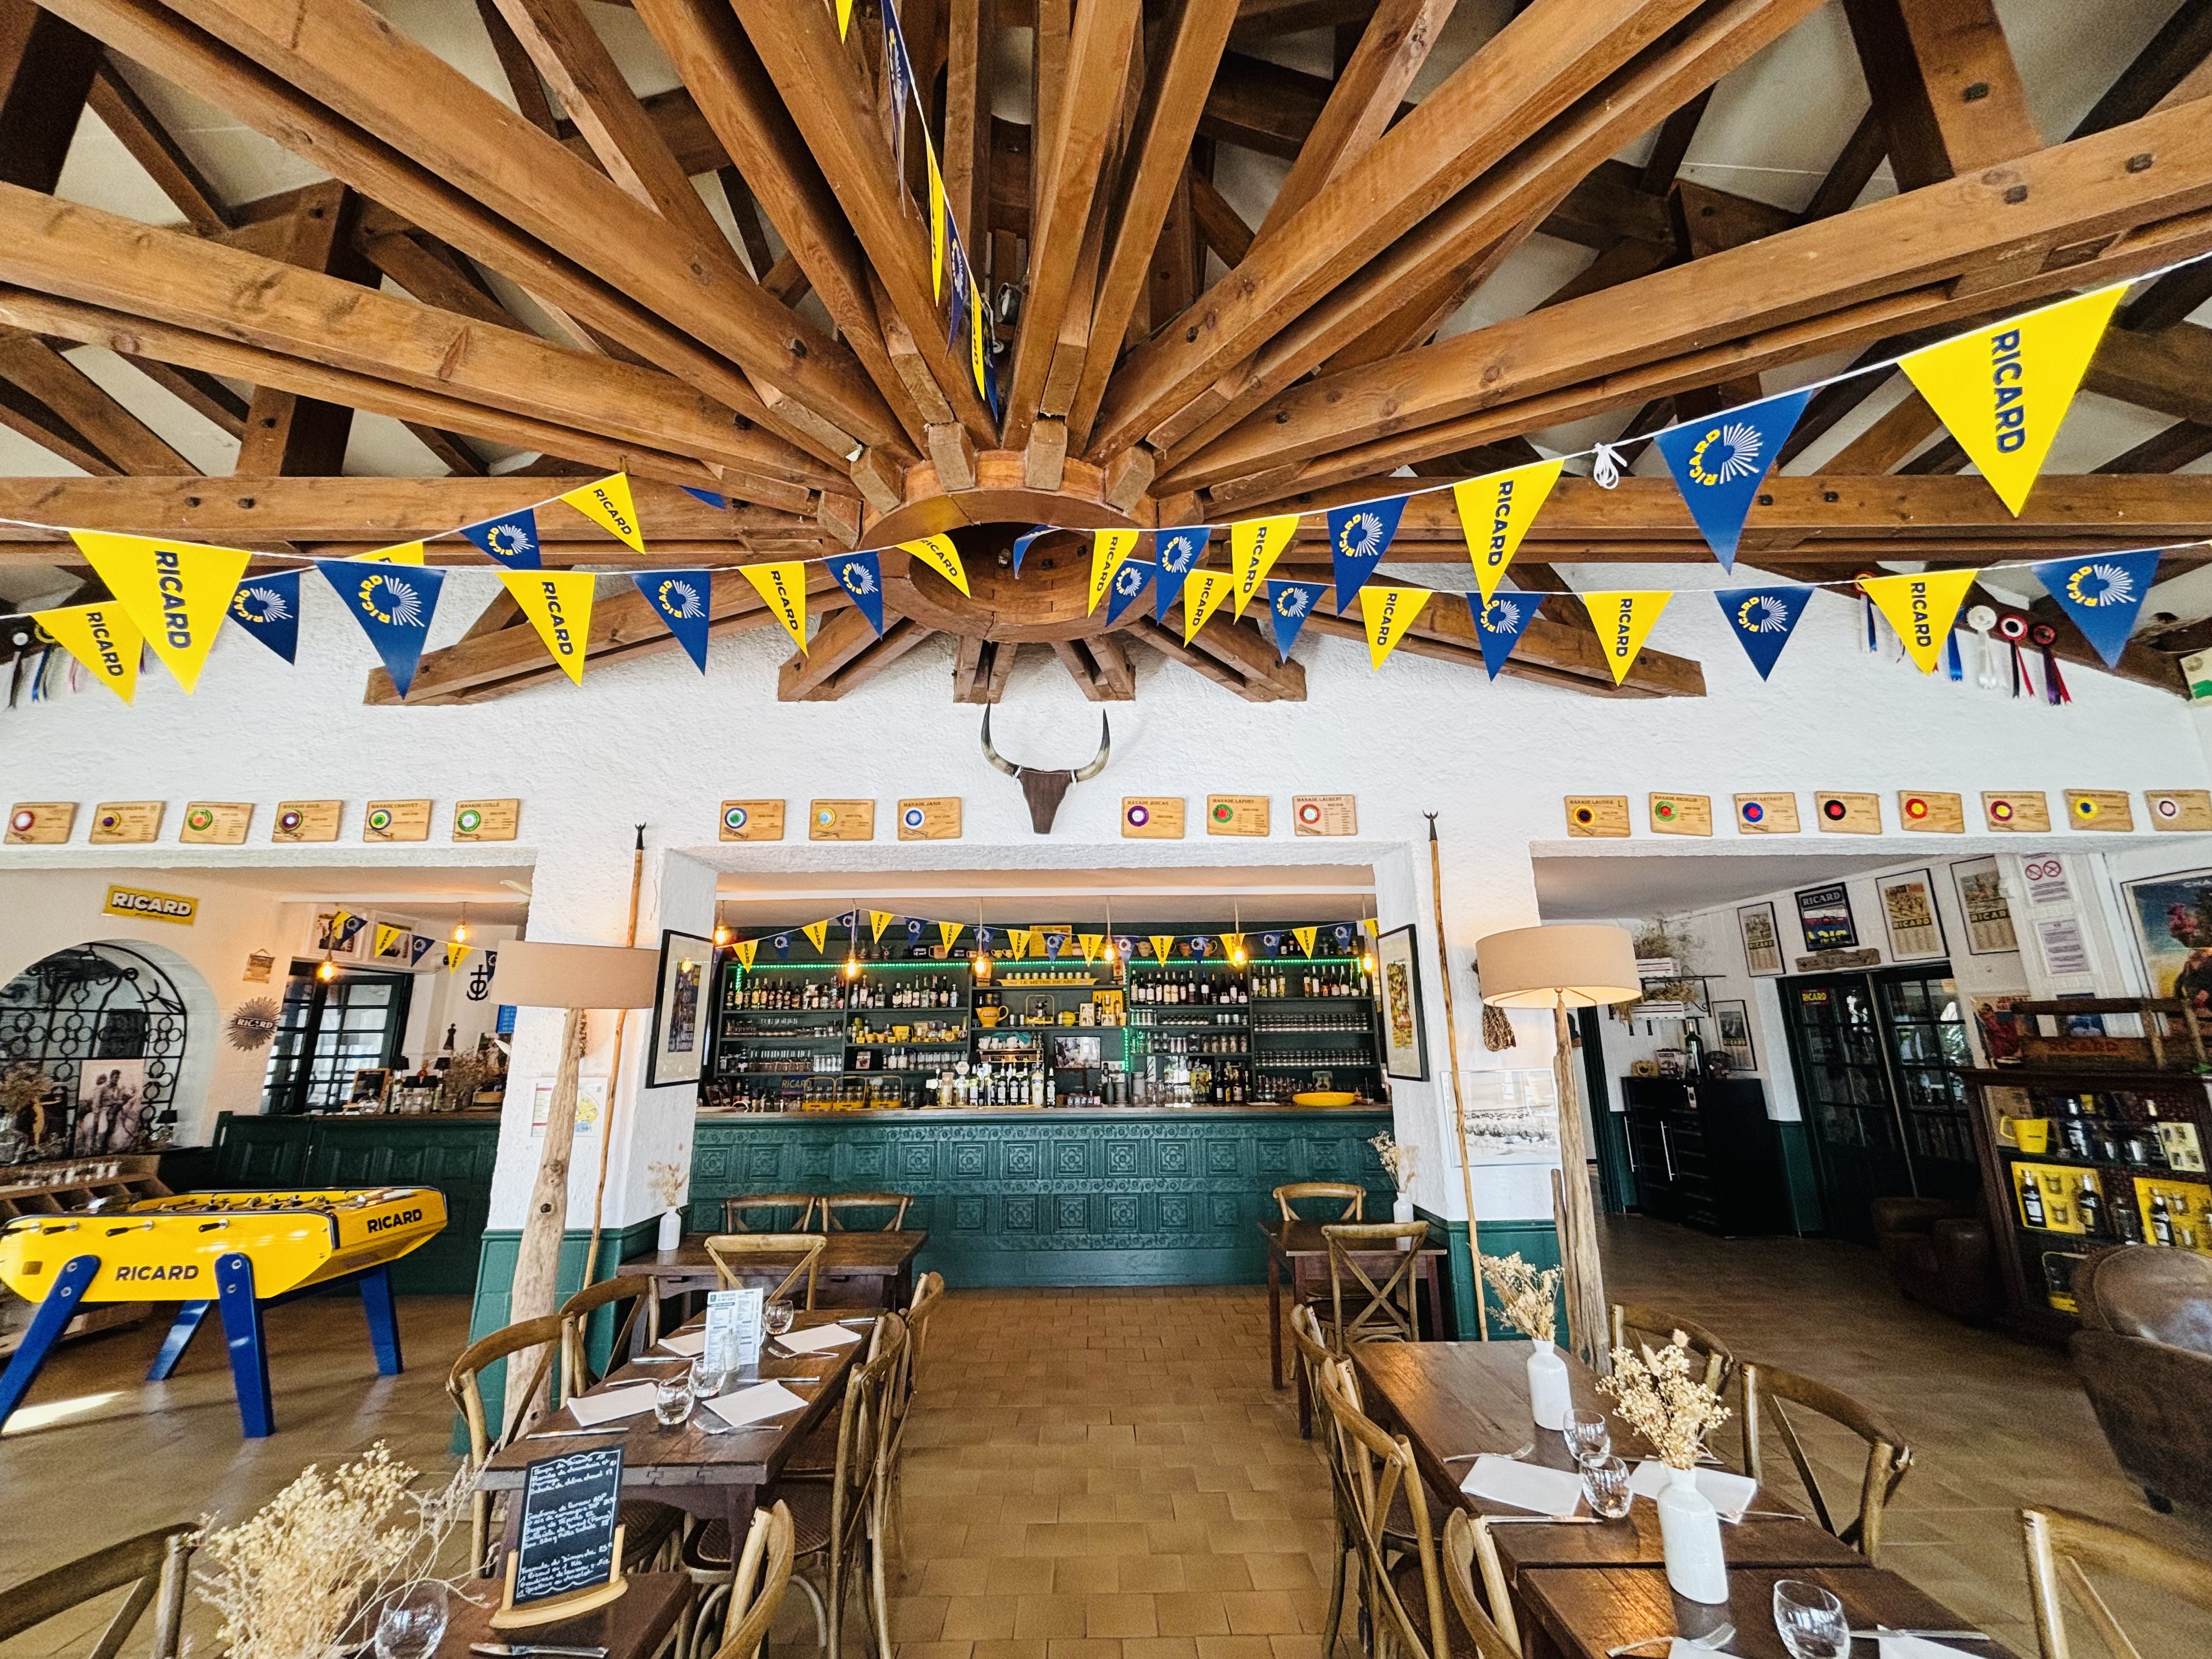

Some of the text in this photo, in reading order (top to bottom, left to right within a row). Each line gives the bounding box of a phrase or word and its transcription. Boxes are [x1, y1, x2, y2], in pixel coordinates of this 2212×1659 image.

[1991, 329, 2025, 453] RICARD
[1689, 428, 1720, 486] RICARD
[593, 488, 631, 535] RICARD
[1487, 479, 1514, 567] RICARD
[488, 527, 513, 556] RICARD
[1162, 536, 1179, 573] RICARD
[1339, 513, 1361, 557] RICARD
[842, 562, 862, 595] RICARD
[1097, 536, 1119, 592] RICARD
[1116, 567, 1131, 596] RICARD
[1243, 527, 1267, 594] RICARD
[154, 550, 192, 649] RICARD
[234, 589, 263, 623] RICARD
[362, 574, 390, 624] RICARD
[658, 580, 682, 619] RICARD
[770, 570, 798, 631] RICARD
[1193, 577, 1214, 627] RICARD
[1277, 587, 1294, 617] RICARD
[2067, 566, 2098, 607] RICARD
[541, 581, 574, 656] RICARD
[1376, 592, 1398, 646] RICARD
[1481, 600, 1500, 633] RICARD
[1616, 598, 1633, 658] RICARD
[1737, 596, 1760, 633] RICARD
[1910, 582, 1932, 647] RICARD
[86, 611, 123, 676] RICARD
[112, 891, 192, 917] RICARD
[1802, 891, 1841, 906] RICARD
[367, 1209, 424, 1233] RICARD
[116, 1265, 199, 1282] RICARD
